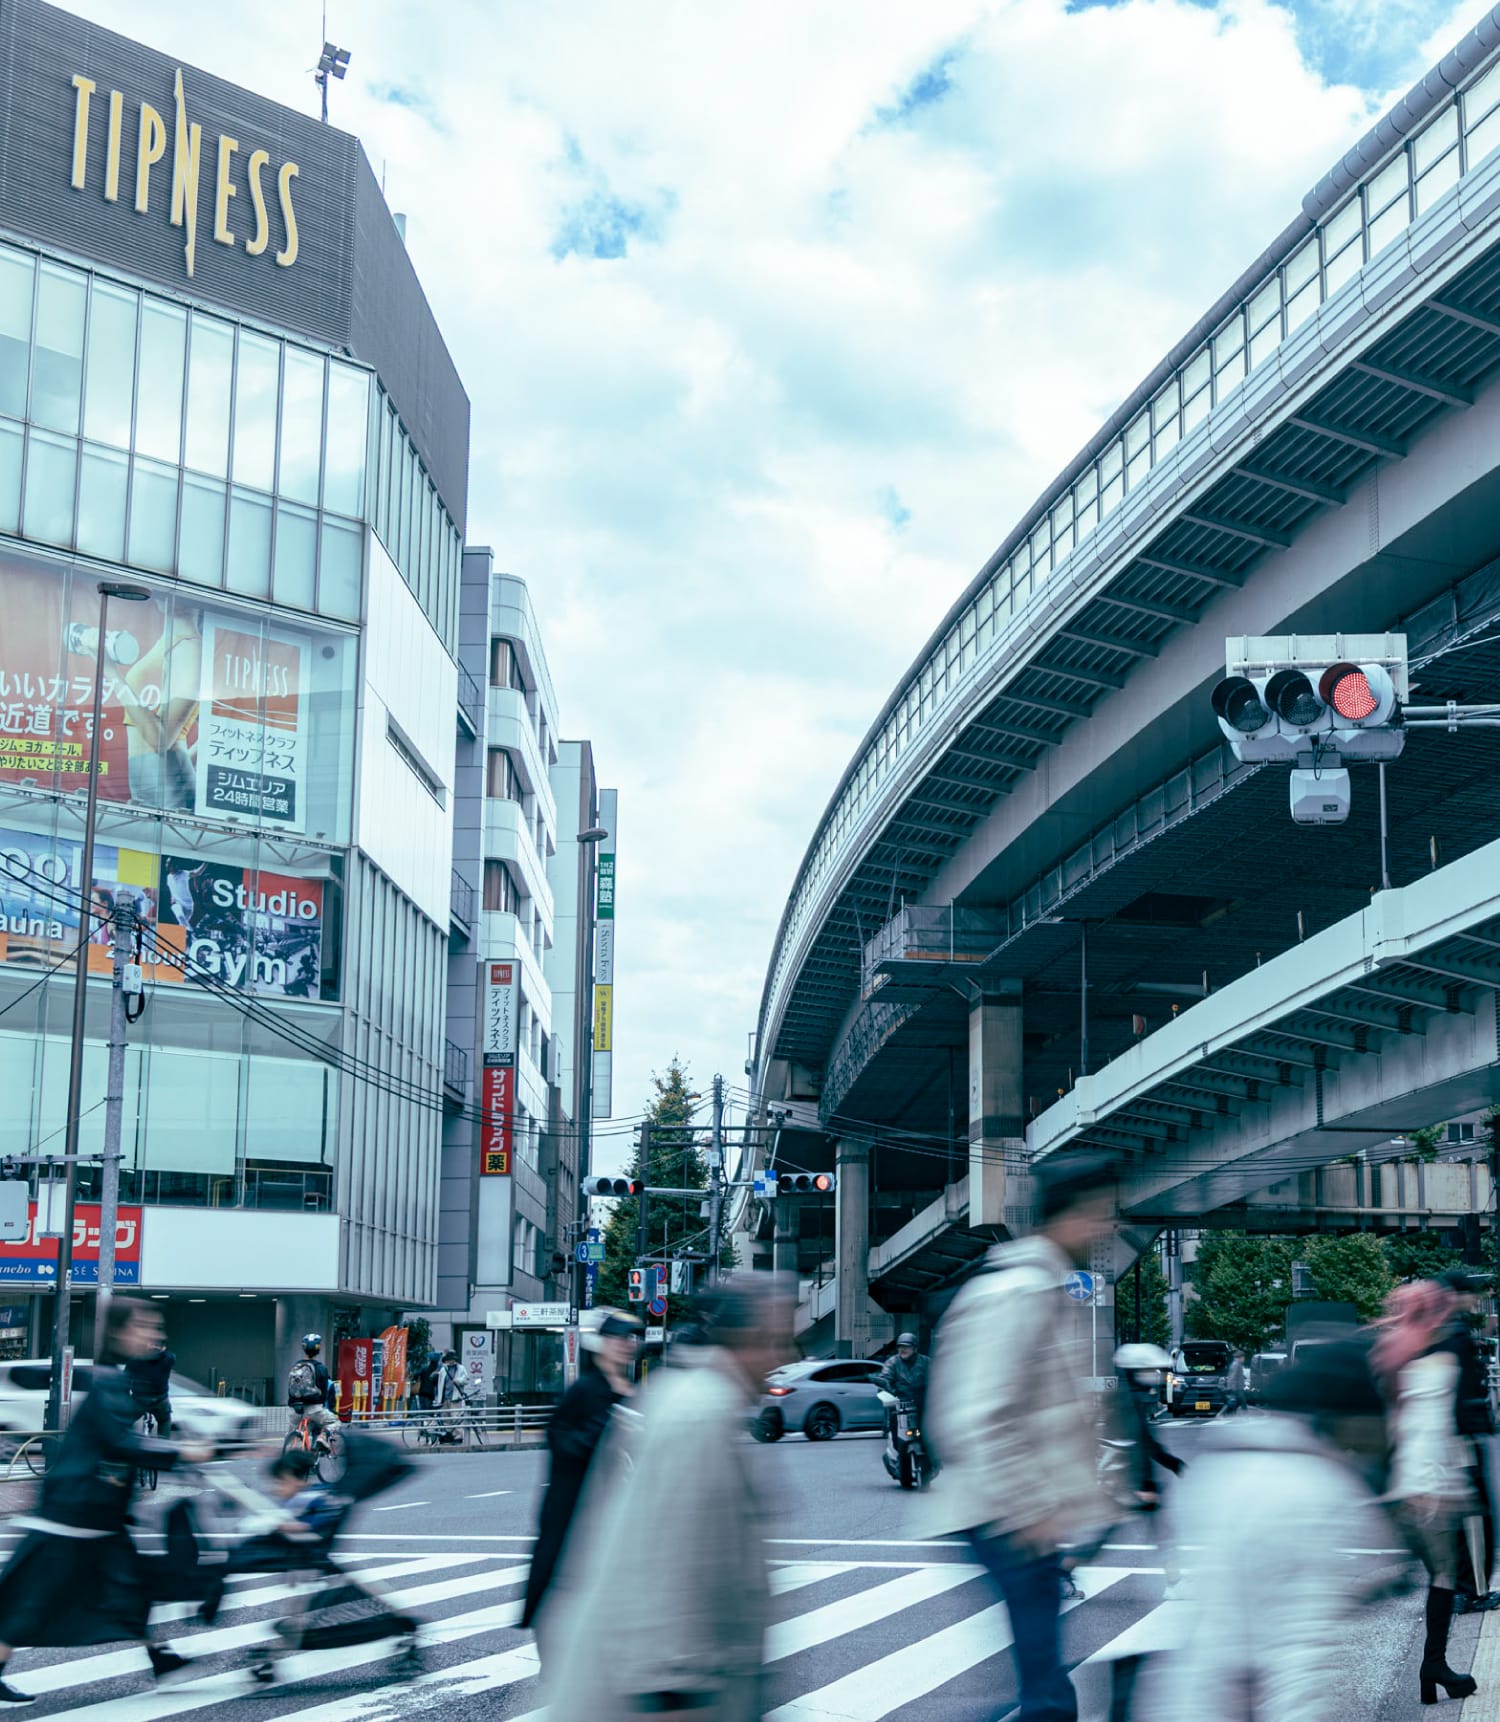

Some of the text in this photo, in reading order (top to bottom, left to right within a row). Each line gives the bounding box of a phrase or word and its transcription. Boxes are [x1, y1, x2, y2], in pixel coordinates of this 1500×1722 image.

[71, 67, 299, 277] TIPNESS
[225, 645, 289, 706] TIPNESS
[0, 702, 114, 742] 近道です。
[209, 740, 296, 773] ティップネス
[213, 787, 289, 814] 24時間営業
[218, 772, 286, 796] ジムエリア
[212, 879, 317, 920] Studio
[188, 938, 286, 986] Gym
[490, 1069, 506, 1151] サンドラッグ
[487, 1154, 505, 1171] 薬
[581, 1245, 587, 1258] 3
